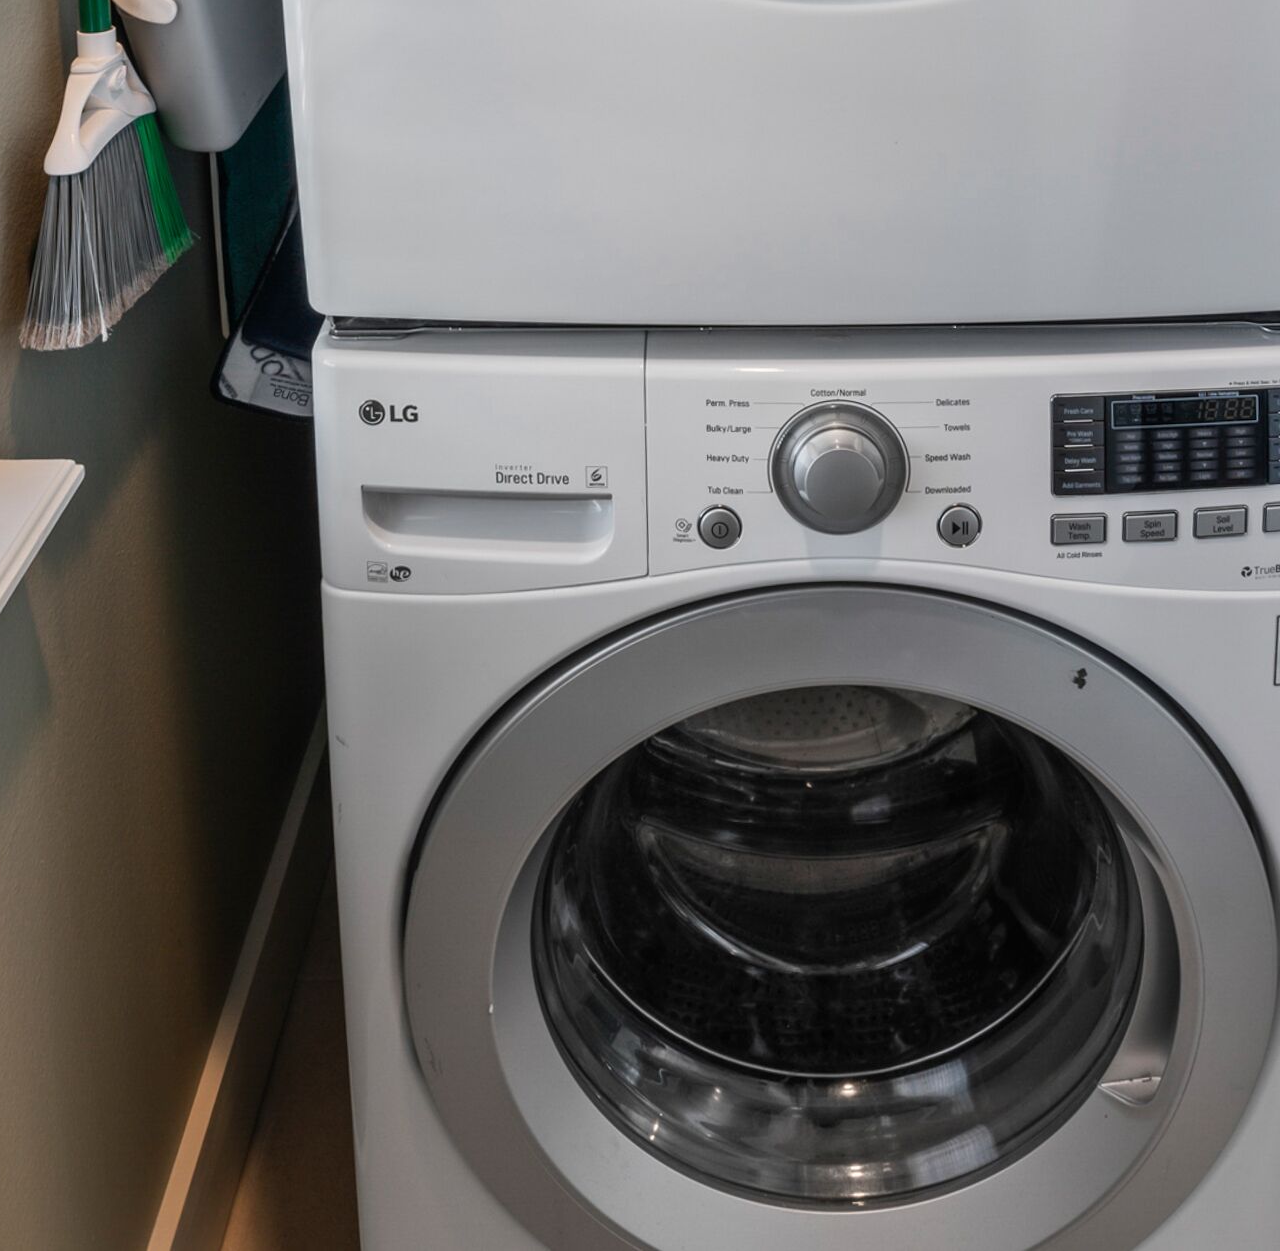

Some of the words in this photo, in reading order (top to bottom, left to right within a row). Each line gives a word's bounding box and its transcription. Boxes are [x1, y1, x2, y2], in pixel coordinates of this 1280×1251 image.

[273, 388, 311, 407] Bona
[810, 389, 866, 398] Cotton/Normal
[729, 400, 750, 408] Press
[935, 398, 971, 407] Delicates
[390, 405, 419, 422] LG
[706, 425, 752, 434] Bulky/Large
[944, 423, 971, 432] Towels
[706, 454, 730, 463] Heavy
[732, 455, 750, 463] Duty
[925, 454, 949, 462] Speed
[950, 453, 971, 461] Wash
[495, 463, 532, 471] Inverter
[1064, 458, 1080, 467] Delay
[496, 471, 534, 484] Direct
[537, 472, 570, 485] Drive
[707, 486, 722, 495] Tub
[723, 487, 744, 495] Clean
[925, 486, 972, 494] Downloaded
[1144, 520, 1162, 529] Spin
[1216, 515, 1231, 525] Soil
[1069, 522, 1091, 530] Wash
[1213, 525, 1234, 534] Level
[1140, 529, 1166, 539] Speed
